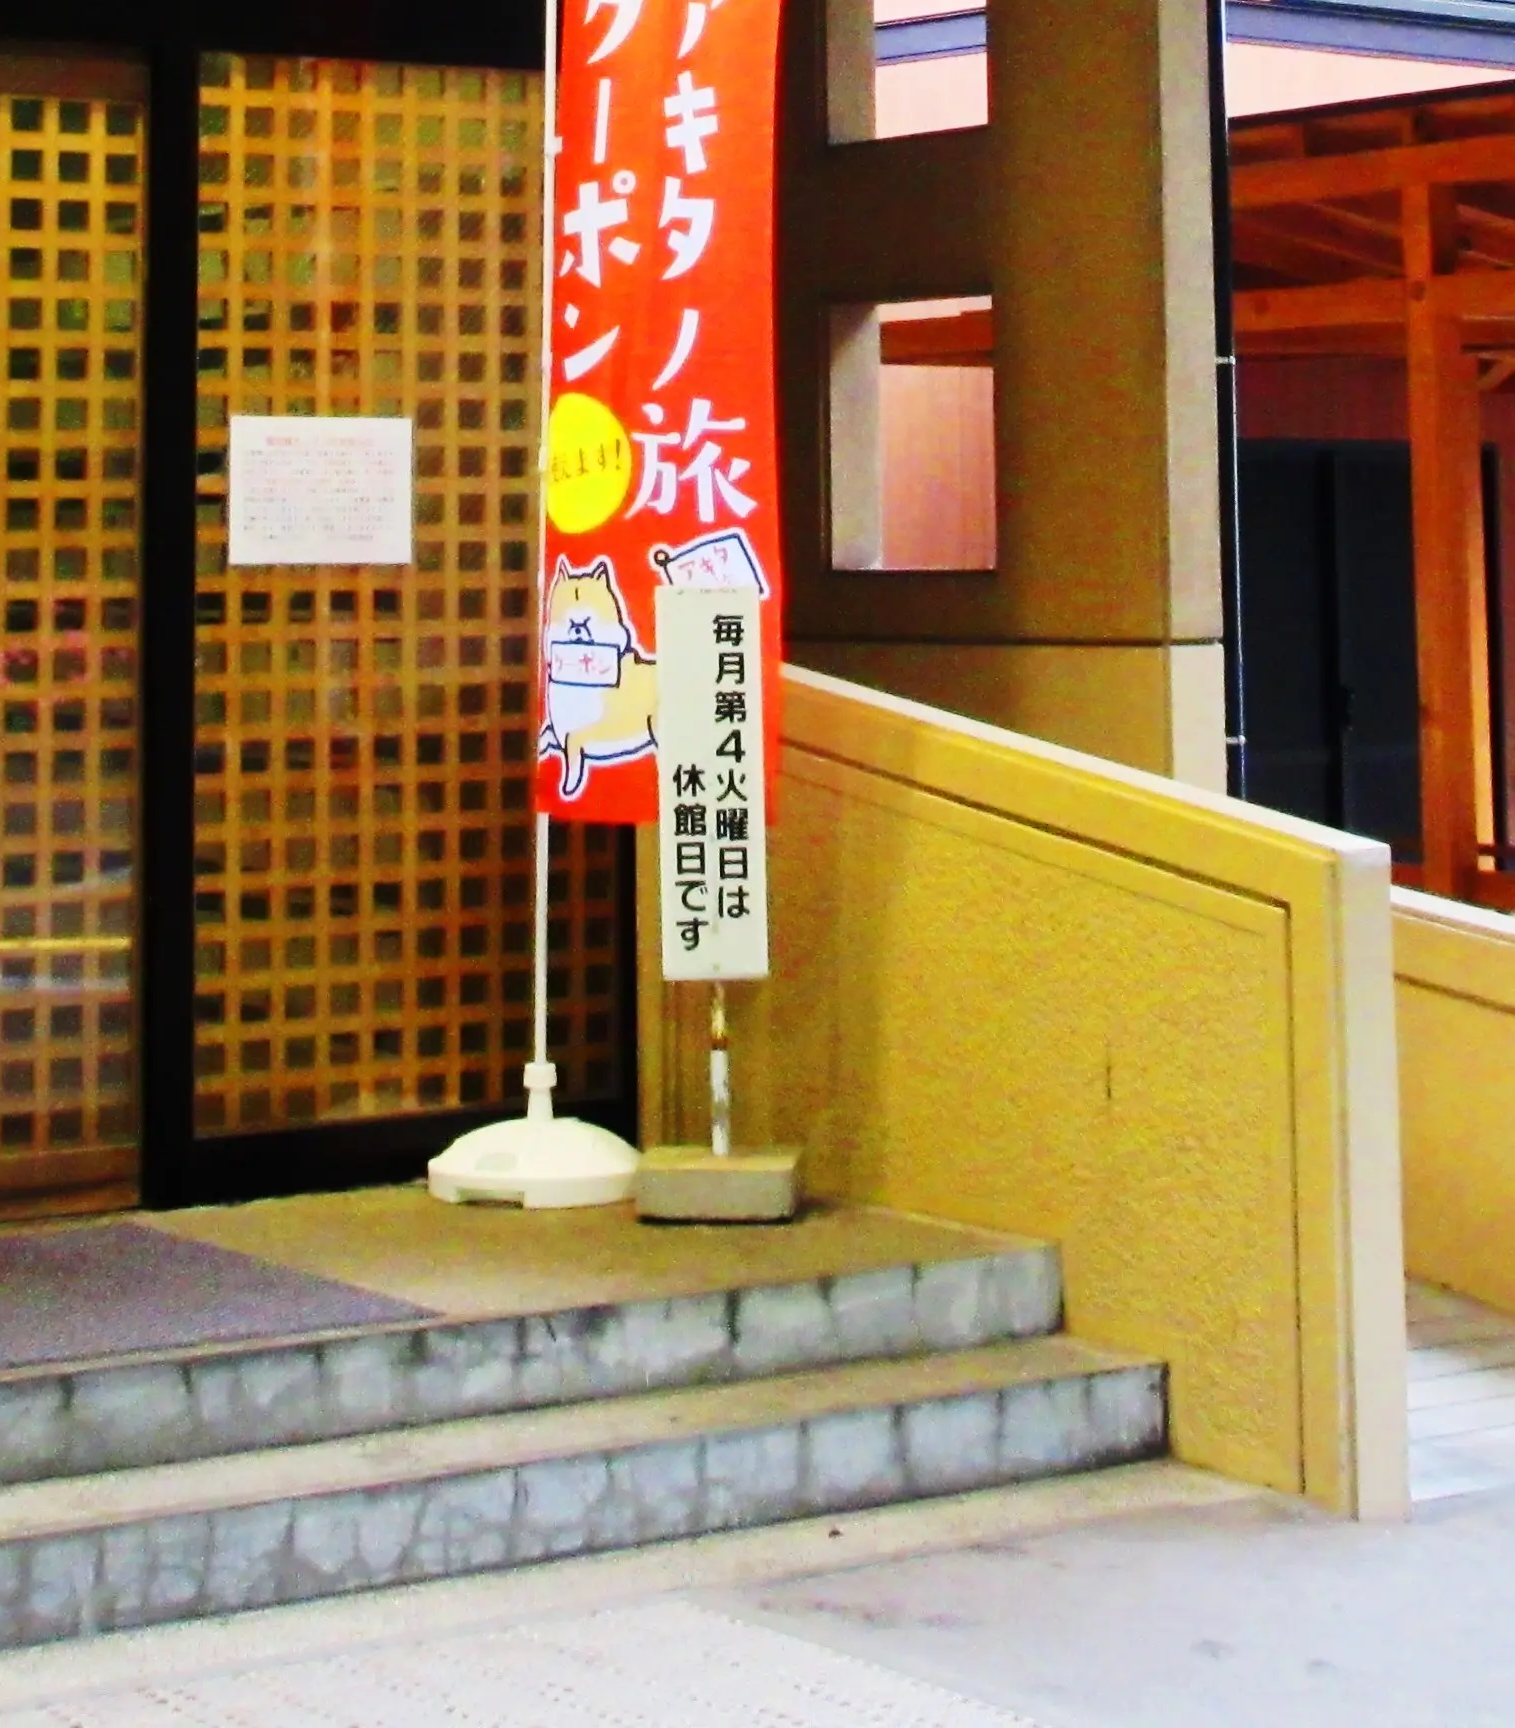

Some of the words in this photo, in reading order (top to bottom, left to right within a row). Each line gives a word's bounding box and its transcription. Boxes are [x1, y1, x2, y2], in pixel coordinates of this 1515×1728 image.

[672, 763, 712, 952] 休館日です
[712, 613, 751, 920] 毎月第4火曜日は
